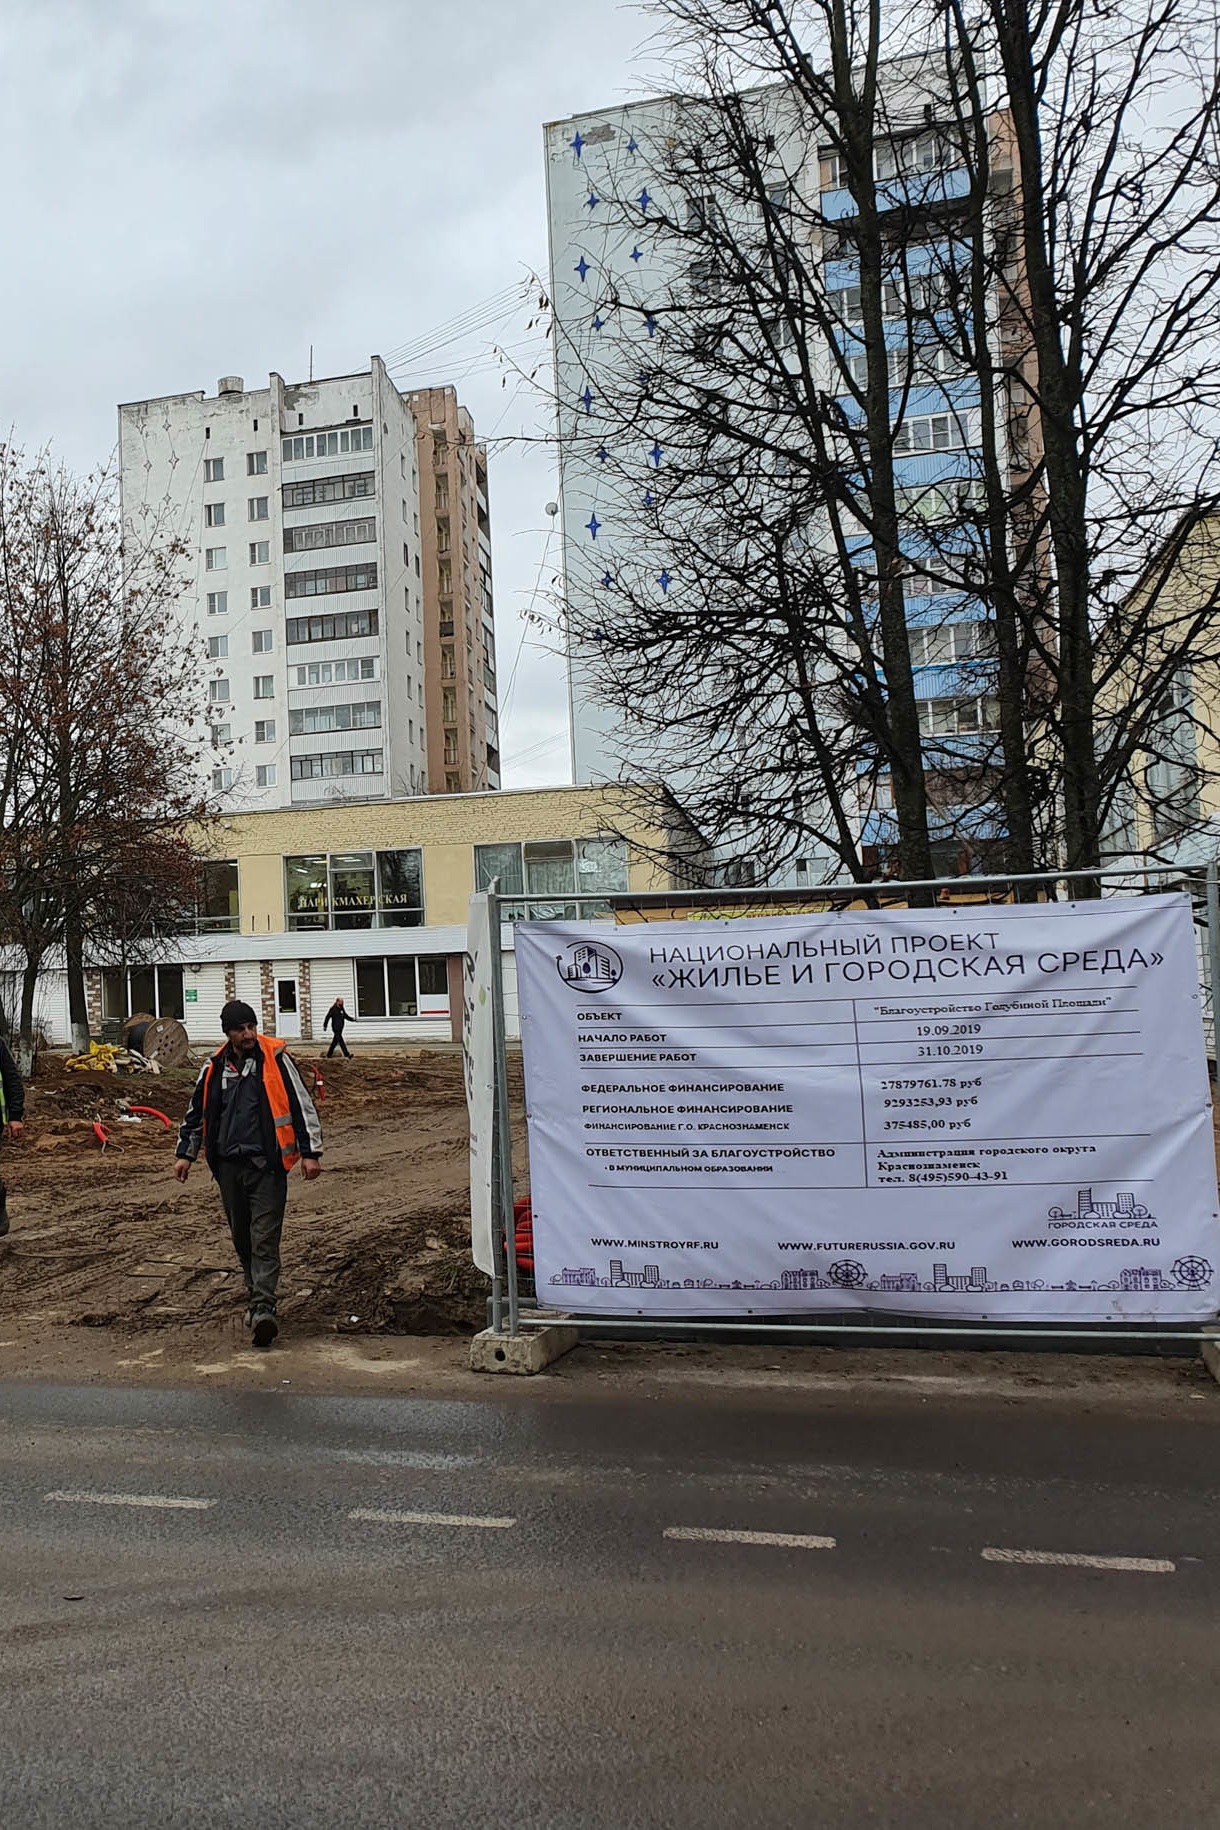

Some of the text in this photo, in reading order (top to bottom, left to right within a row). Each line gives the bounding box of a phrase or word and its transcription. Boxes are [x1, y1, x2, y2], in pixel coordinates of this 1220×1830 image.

[649, 931, 1000, 965] НАЦИОНАЛЬНЫЙ ПРОЕКТ
[651, 947, 1164, 989] «ЖИЛЬЕ И ГОРОДСКАЯ СРЕДА»
[577, 1012, 622, 1021] ОБЪЕКТ
[916, 1023, 982, 1036] 19.09.2019
[578, 1033, 667, 1043] НАЧАЛО РАБОТ
[917, 1044, 984, 1057] 31.10.2019
[579, 1053, 697, 1062] ЗАВЕРШЕНИЕ РАБОТ
[581, 1083, 785, 1094] ФЕДЕРАЛЬНОЕ ФИНАНСИРОВАНИЕ
[960, 1077, 983, 1089] руб
[956, 1095, 978, 1108] руб
[582, 1104, 793, 1114] РЕГИОНАЛЬНОЕ ФИНАНСИРОВАНИЕ
[584, 1123, 676, 1131] ФИНАНСИРОВАНИЕ
[697, 1122, 790, 1131] КРАСНОЗНАМЕНСК
[949, 1118, 972, 1130] руб
[586, 1147, 835, 1158] ОТВЕТСТВЕННЫЙ ЗА БЛАГОУСТРОЙСТВО
[978, 1145, 1049, 1157] городского
[1052, 1145, 1097, 1155] округа
[616, 1164, 702, 1173] МУНИЦИПАЛЬНОМ
[703, 1165, 773, 1173] ОБРАЗОВАНИИ
[878, 1175, 905, 1184] тел.
[1048, 1220, 1159, 1230] ГОРОДСКАЯ СРЕДА
[590, 1238, 719, 1250] WWW.MINSTROYRF.RU
[777, 1241, 956, 1251] WWW.FUTURERUSSIA.GOV.RU
[1011, 1238, 1161, 1249] WWW.GORODSREDA.RU
